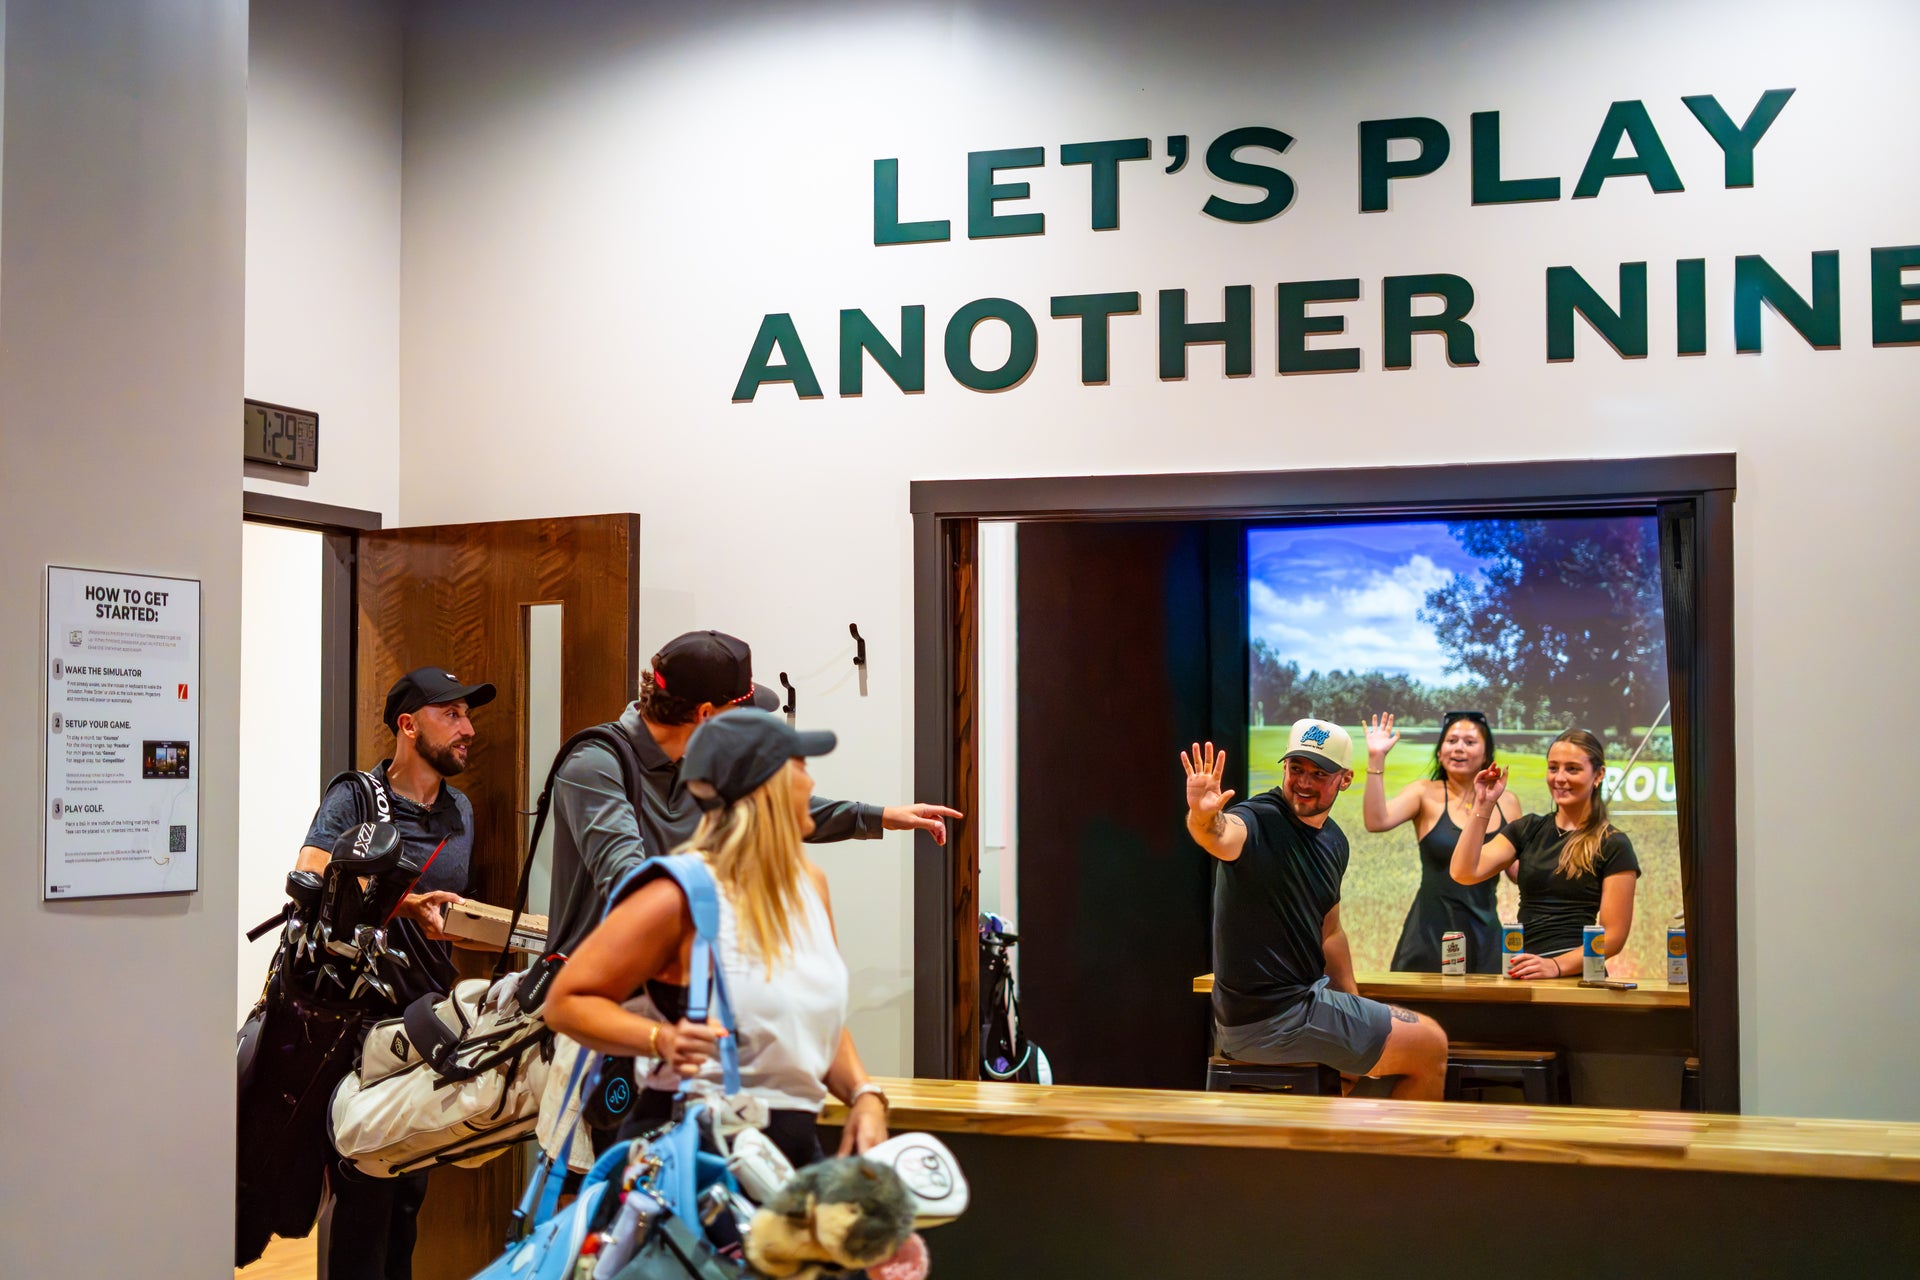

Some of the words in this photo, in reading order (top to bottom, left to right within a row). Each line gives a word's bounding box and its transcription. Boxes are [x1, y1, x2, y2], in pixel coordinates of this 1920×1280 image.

[874, 126, 1296, 246] LET’S
[1358, 88, 1796, 213] PLAY
[731, 273, 1480, 403] ANOTHER
[1546, 245, 1920, 363] NINE
[256, 408, 297, 461] 7:29
[86, 586, 120, 603] HOW
[124, 589, 141, 604] TO
[144, 591, 169, 606] GET
[96, 604, 159, 622] STARTED:
[65, 666, 86, 675] WAKE
[88, 667, 101, 676] THE
[103, 668, 142, 677] SIMULATOR
[55, 718, 60, 728] 2
[65, 720, 88, 728] SETUP
[90, 720, 108, 729] YOUR
[110, 721, 131, 729] GAME.
[55, 804, 60, 814] 3
[65, 805, 83, 813] PLAY
[84, 804, 104, 813] GOLF.
[528, 970, 549, 1000] GARMIN
